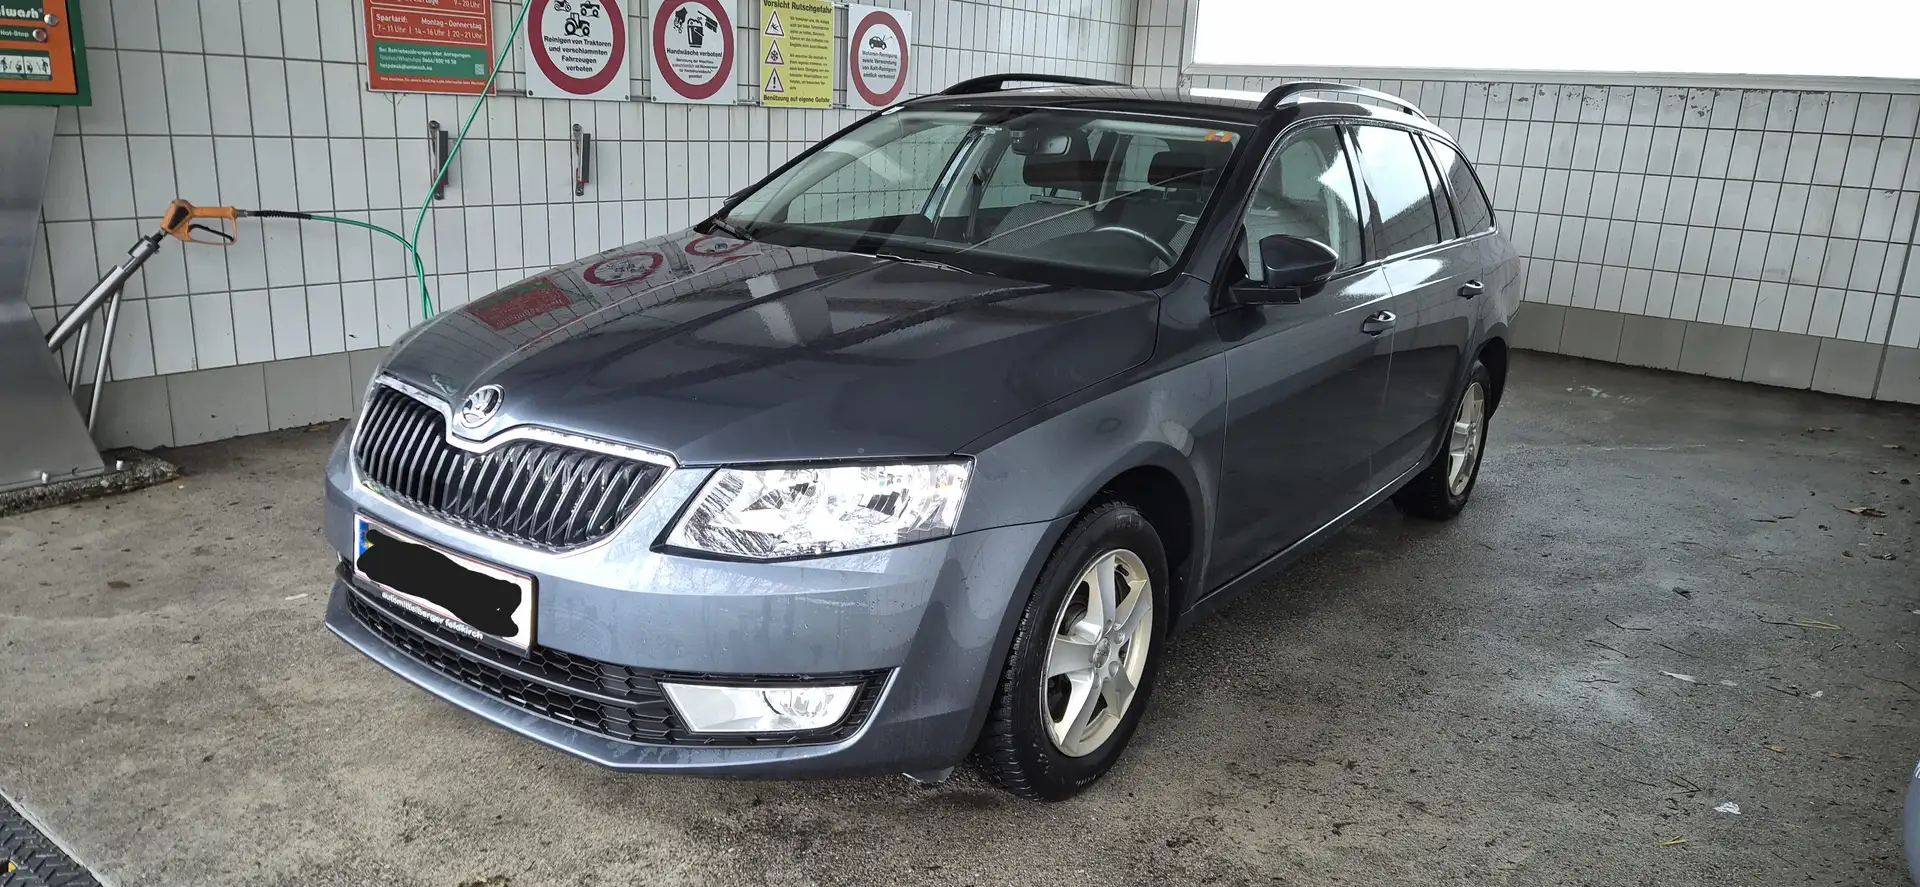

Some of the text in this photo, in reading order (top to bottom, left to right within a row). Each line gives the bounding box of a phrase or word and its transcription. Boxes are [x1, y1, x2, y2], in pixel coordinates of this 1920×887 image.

[763, 0, 832, 14] Vorsicht Rutschgefahr
[376, 13, 408, 23] Spartarif:
[421, 18, 443, 27] Montag
[448, 20, 482, 30] Donnerstag
[394, 25, 406, 33] Uhr
[544, 36, 571, 45] Reinigen
[584, 39, 612, 47] Traktoren
[562, 47, 608, 56] verschlammten
[666, 48, 699, 56] Handwäsche
[862, 50, 897, 59] Motoren-Reinigung
[561, 55, 597, 64] Fahrzeugen
[874, 59, 897, 67] Verwendung
[445, 618, 484, 640] feldkirch
